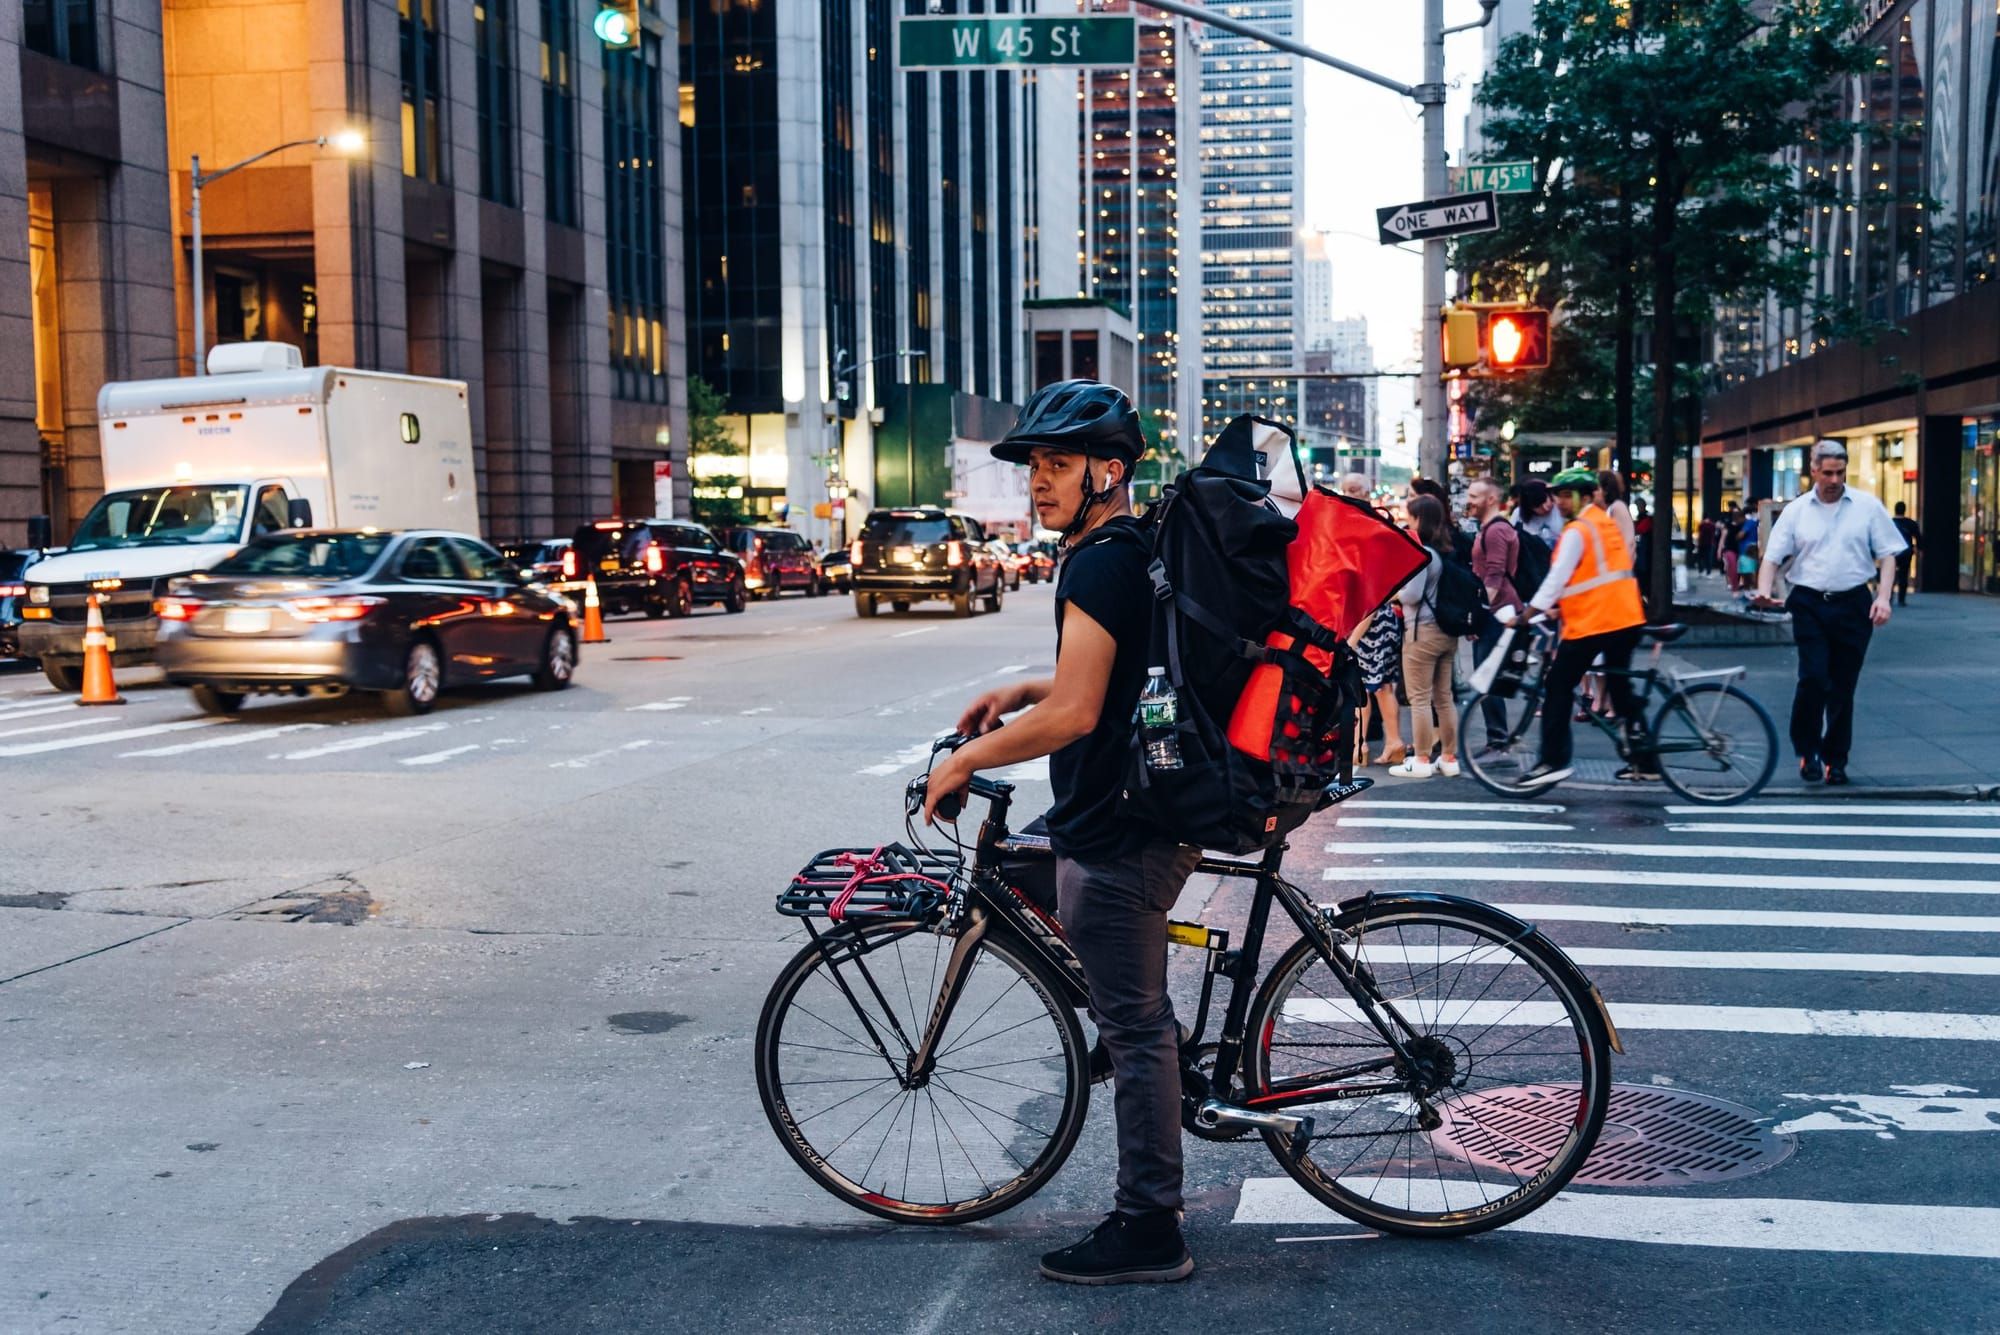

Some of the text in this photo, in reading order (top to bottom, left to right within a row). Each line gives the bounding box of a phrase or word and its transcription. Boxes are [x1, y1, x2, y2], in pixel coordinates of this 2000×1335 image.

[952, 25, 1081, 57] W 45 St
[1470, 166, 1527, 191] W 45 ST
[1395, 204, 1479, 231] ONE WAY
[1346, 1087, 1383, 1098] SCOTT
